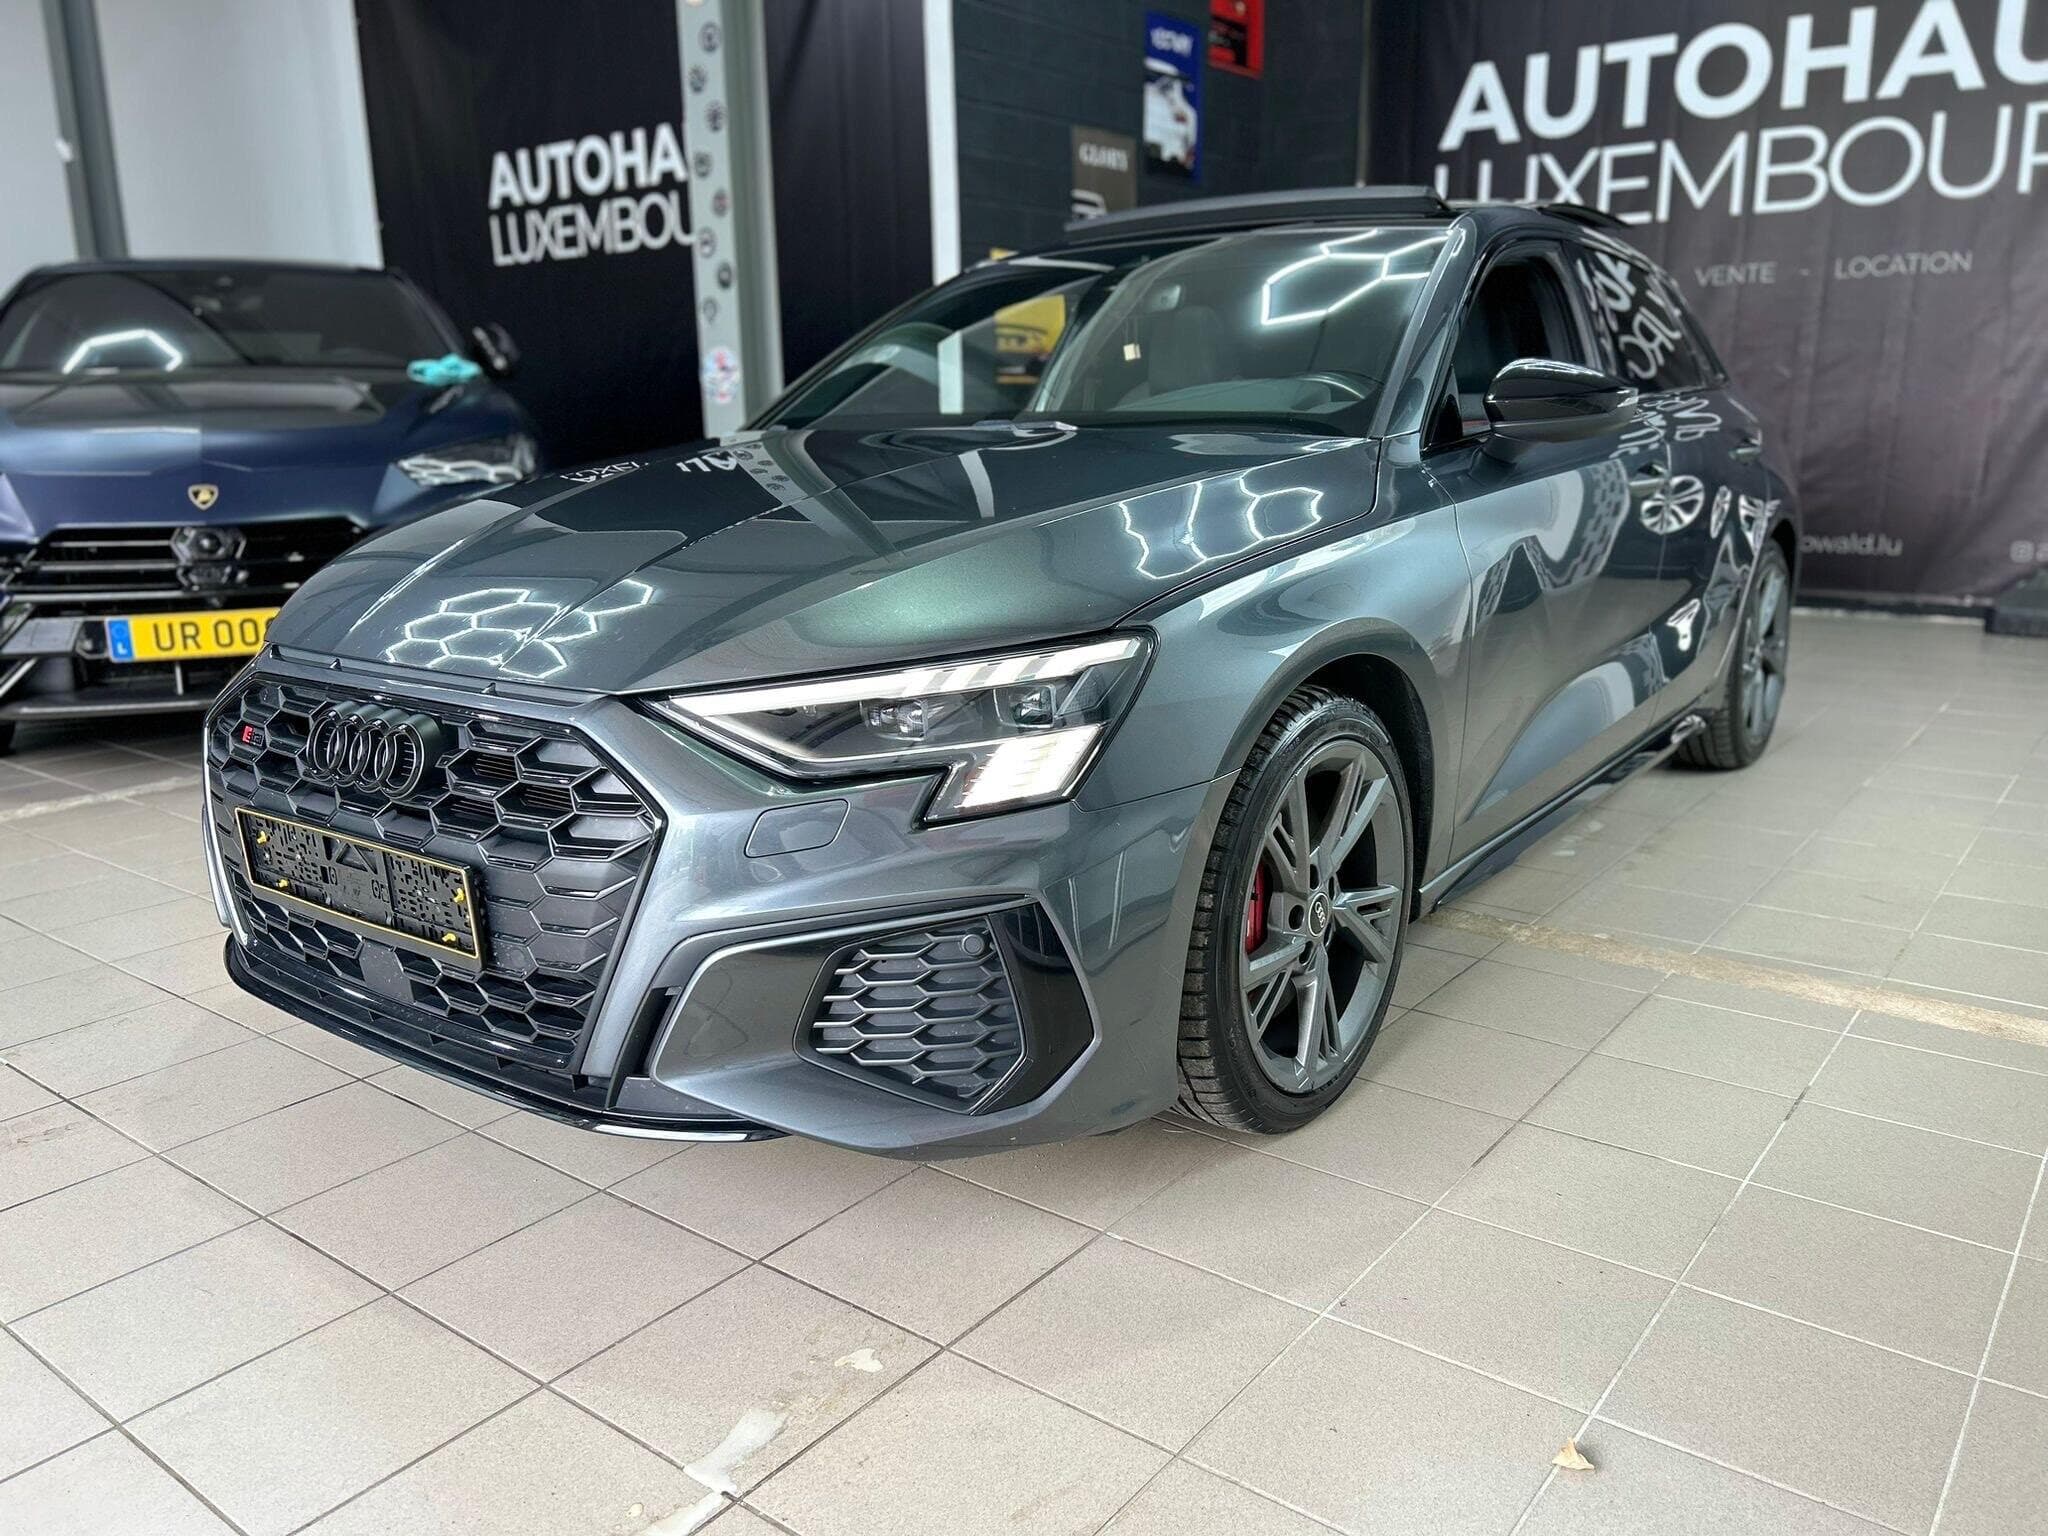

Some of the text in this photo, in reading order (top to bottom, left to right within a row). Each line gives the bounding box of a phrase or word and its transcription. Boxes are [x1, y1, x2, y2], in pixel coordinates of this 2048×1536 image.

[488, 121, 689, 210] AUTOHA
[1694, 261, 1777, 288] VENTE
[1833, 249, 1973, 281] LOCATION
[152, 617, 275, 652] UR 00
